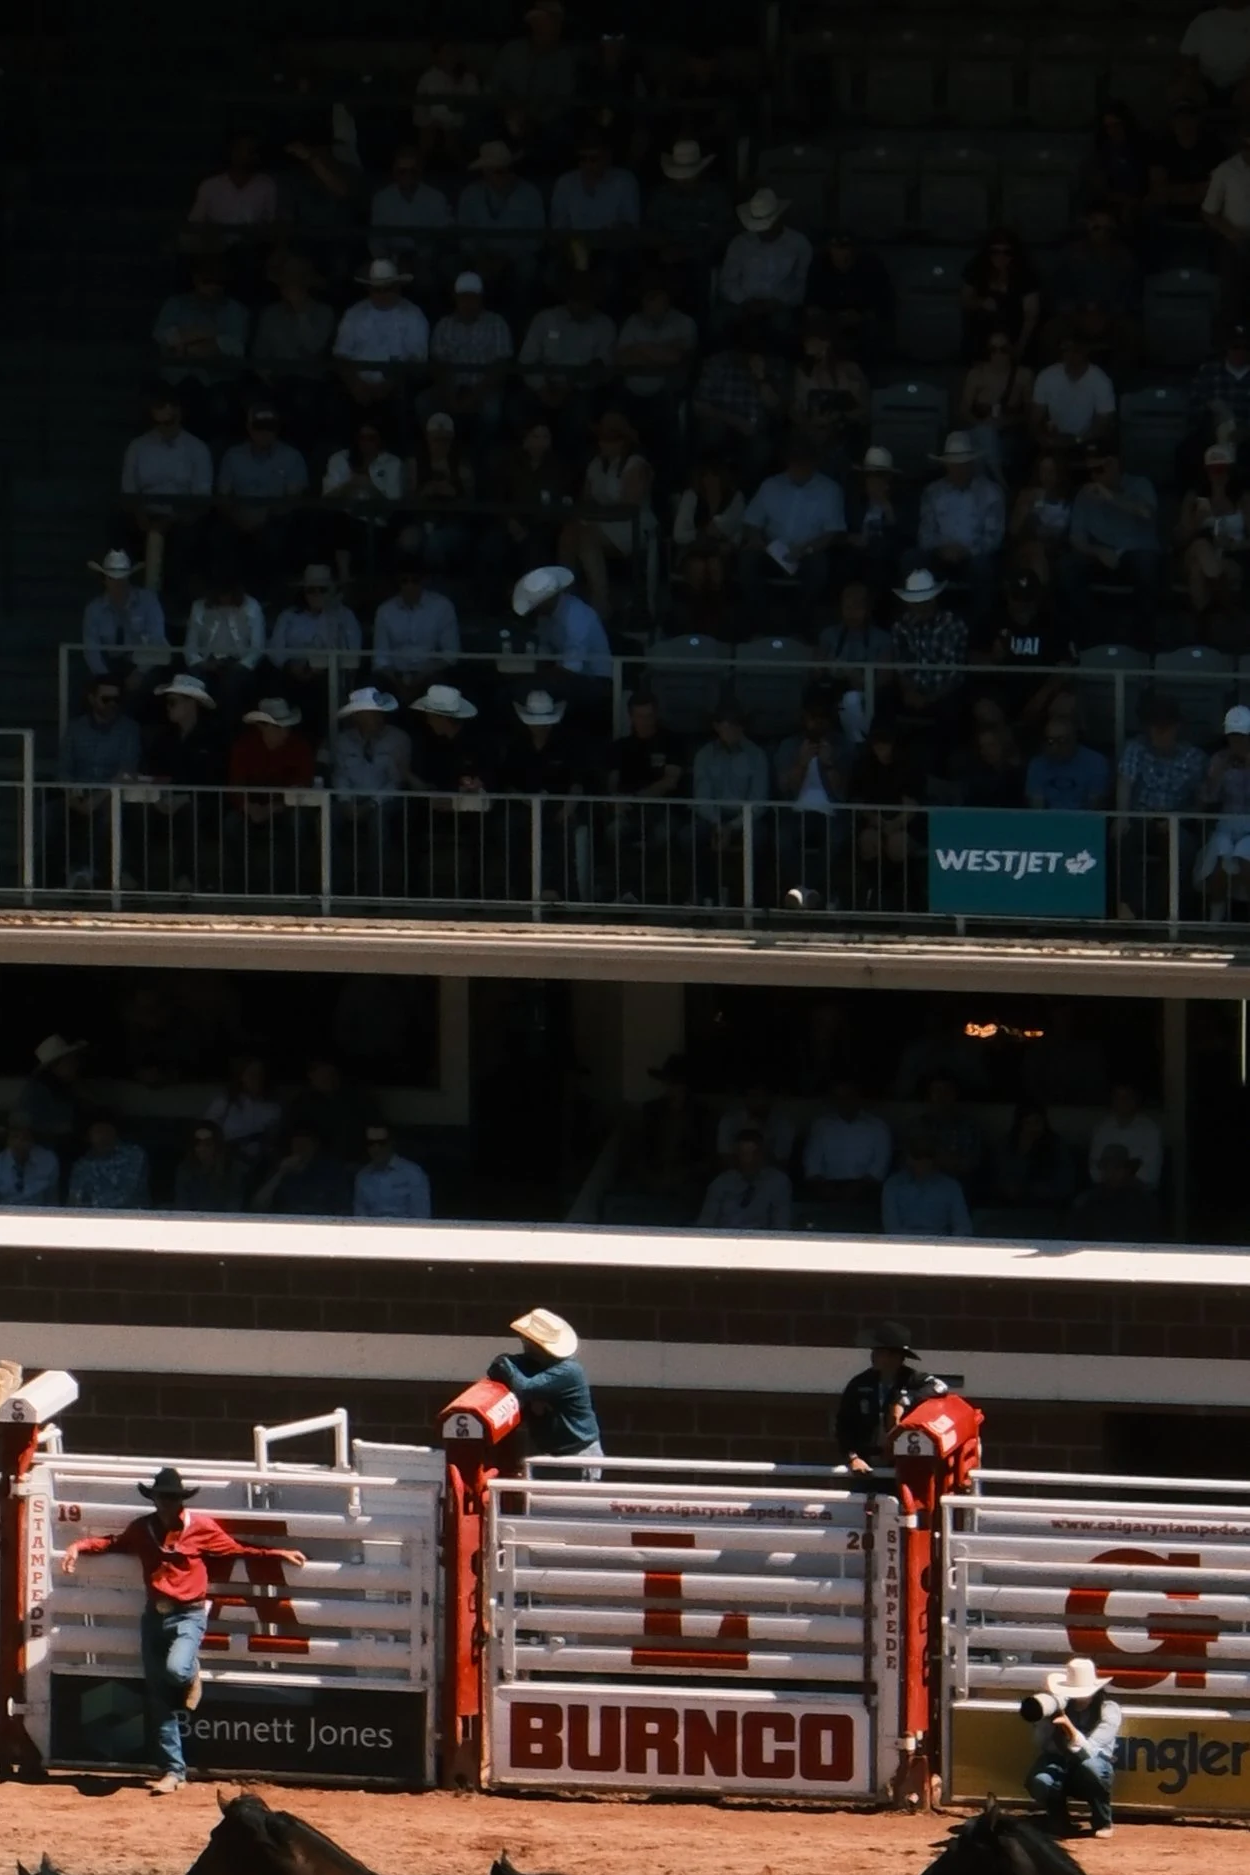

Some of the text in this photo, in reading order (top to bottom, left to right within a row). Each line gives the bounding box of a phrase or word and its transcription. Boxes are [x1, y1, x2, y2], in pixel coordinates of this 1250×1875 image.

[935, 849, 1064, 880] WESTJET
[57, 1504, 82, 1522] 19
[29, 1500, 46, 1639] STAMPEDE
[884, 1529, 899, 1670] STAMPEDE
[172, 1710, 394, 1752] Bennett Jones
[510, 1701, 854, 1782] BURNCO
